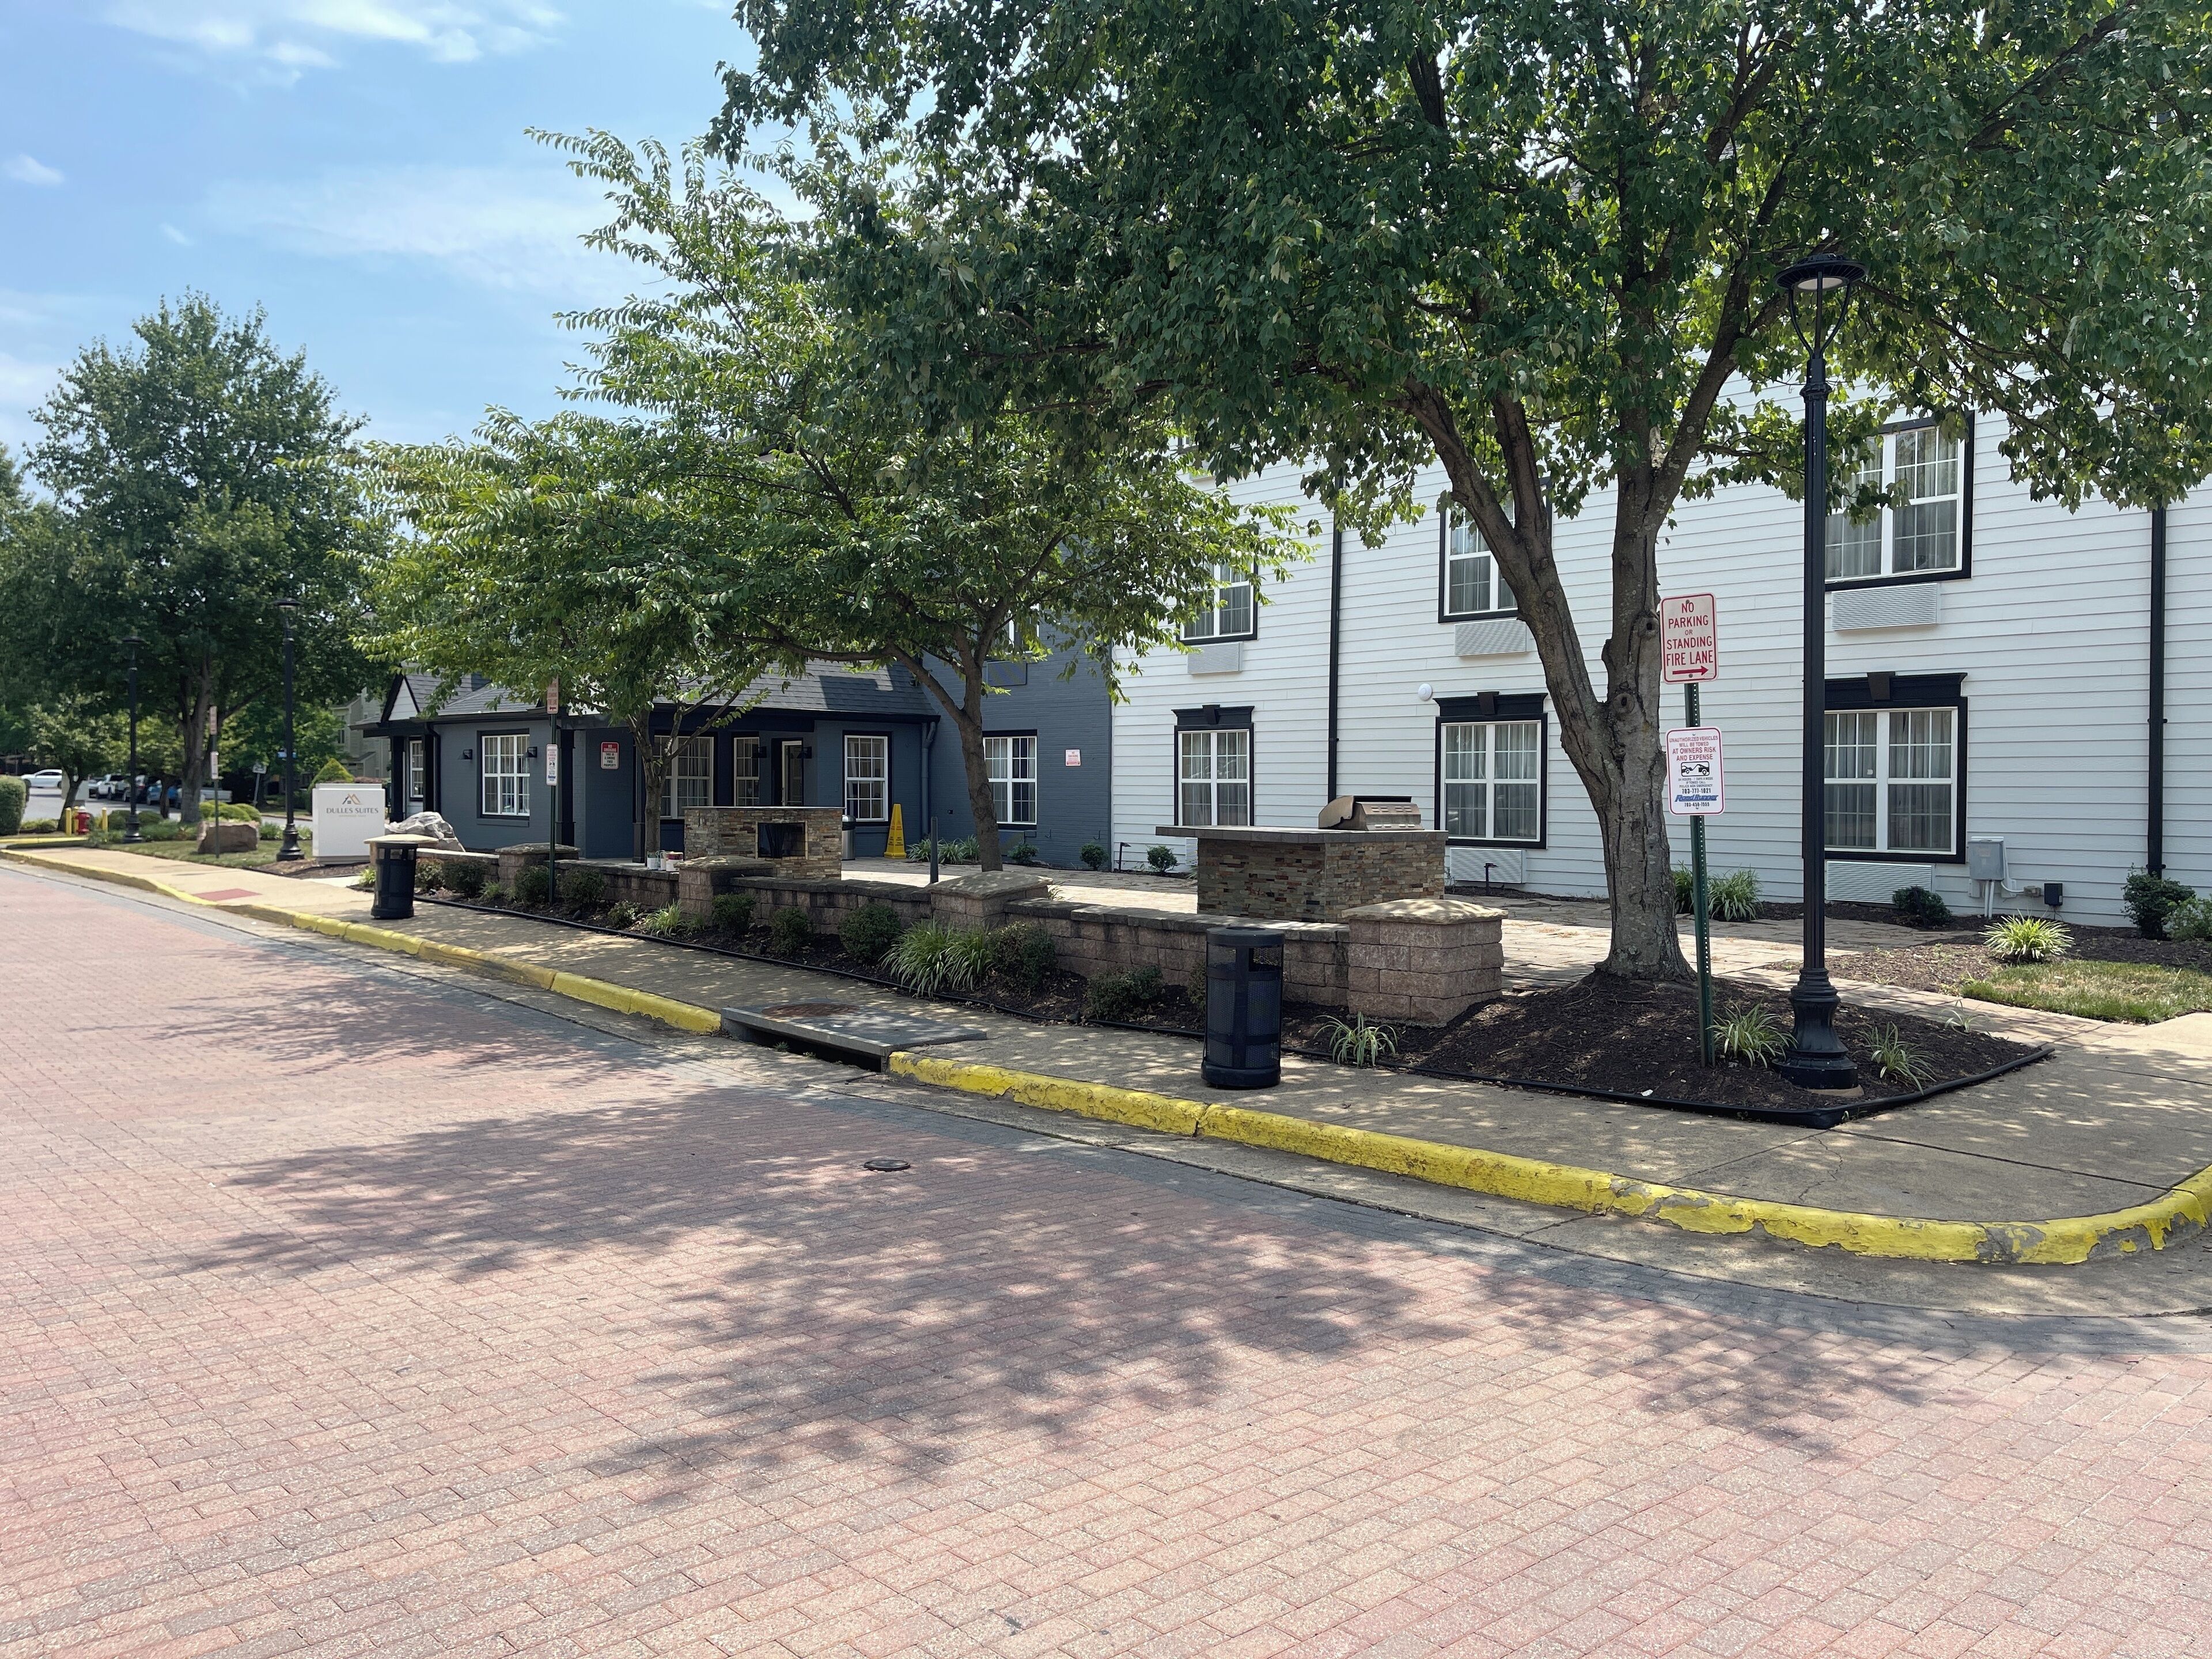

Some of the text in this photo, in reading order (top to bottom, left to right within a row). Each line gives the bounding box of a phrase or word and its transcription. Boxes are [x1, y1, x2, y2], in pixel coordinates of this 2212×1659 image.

[1681, 602, 1694, 613] NO
[1668, 615, 1709, 629] PARKING
[1666, 635, 1712, 650] STANDING
[1666, 650, 1714, 666] FIRE LANE
